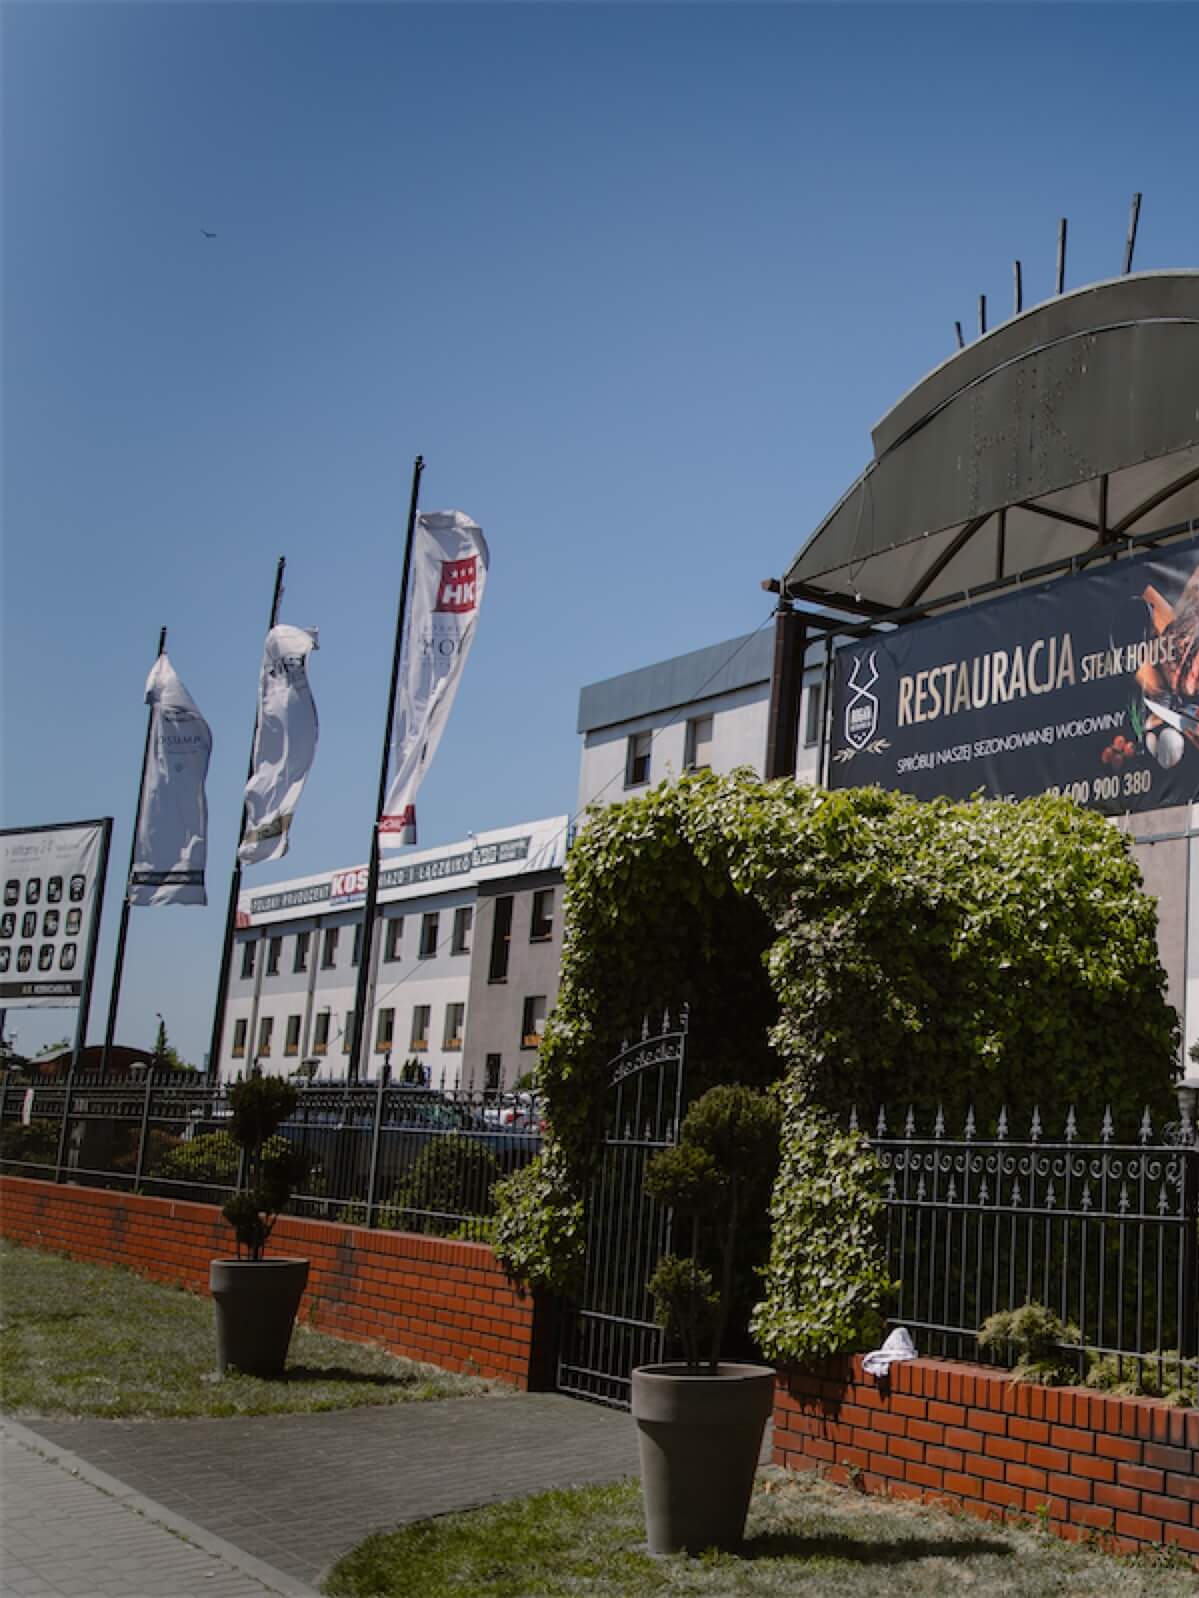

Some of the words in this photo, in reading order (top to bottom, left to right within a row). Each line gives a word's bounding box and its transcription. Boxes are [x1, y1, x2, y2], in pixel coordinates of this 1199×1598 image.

[897, 632, 1077, 727] RESTAURACJA
[1081, 647, 1123, 683] STEAK
[1126, 635, 1177, 673] HOUSE
[936, 745, 971, 765] NASZEJ
[974, 726, 1055, 758] SEZONOWANEJ
[1093, 775, 1119, 801] 900
[1123, 769, 1151, 796] 380
